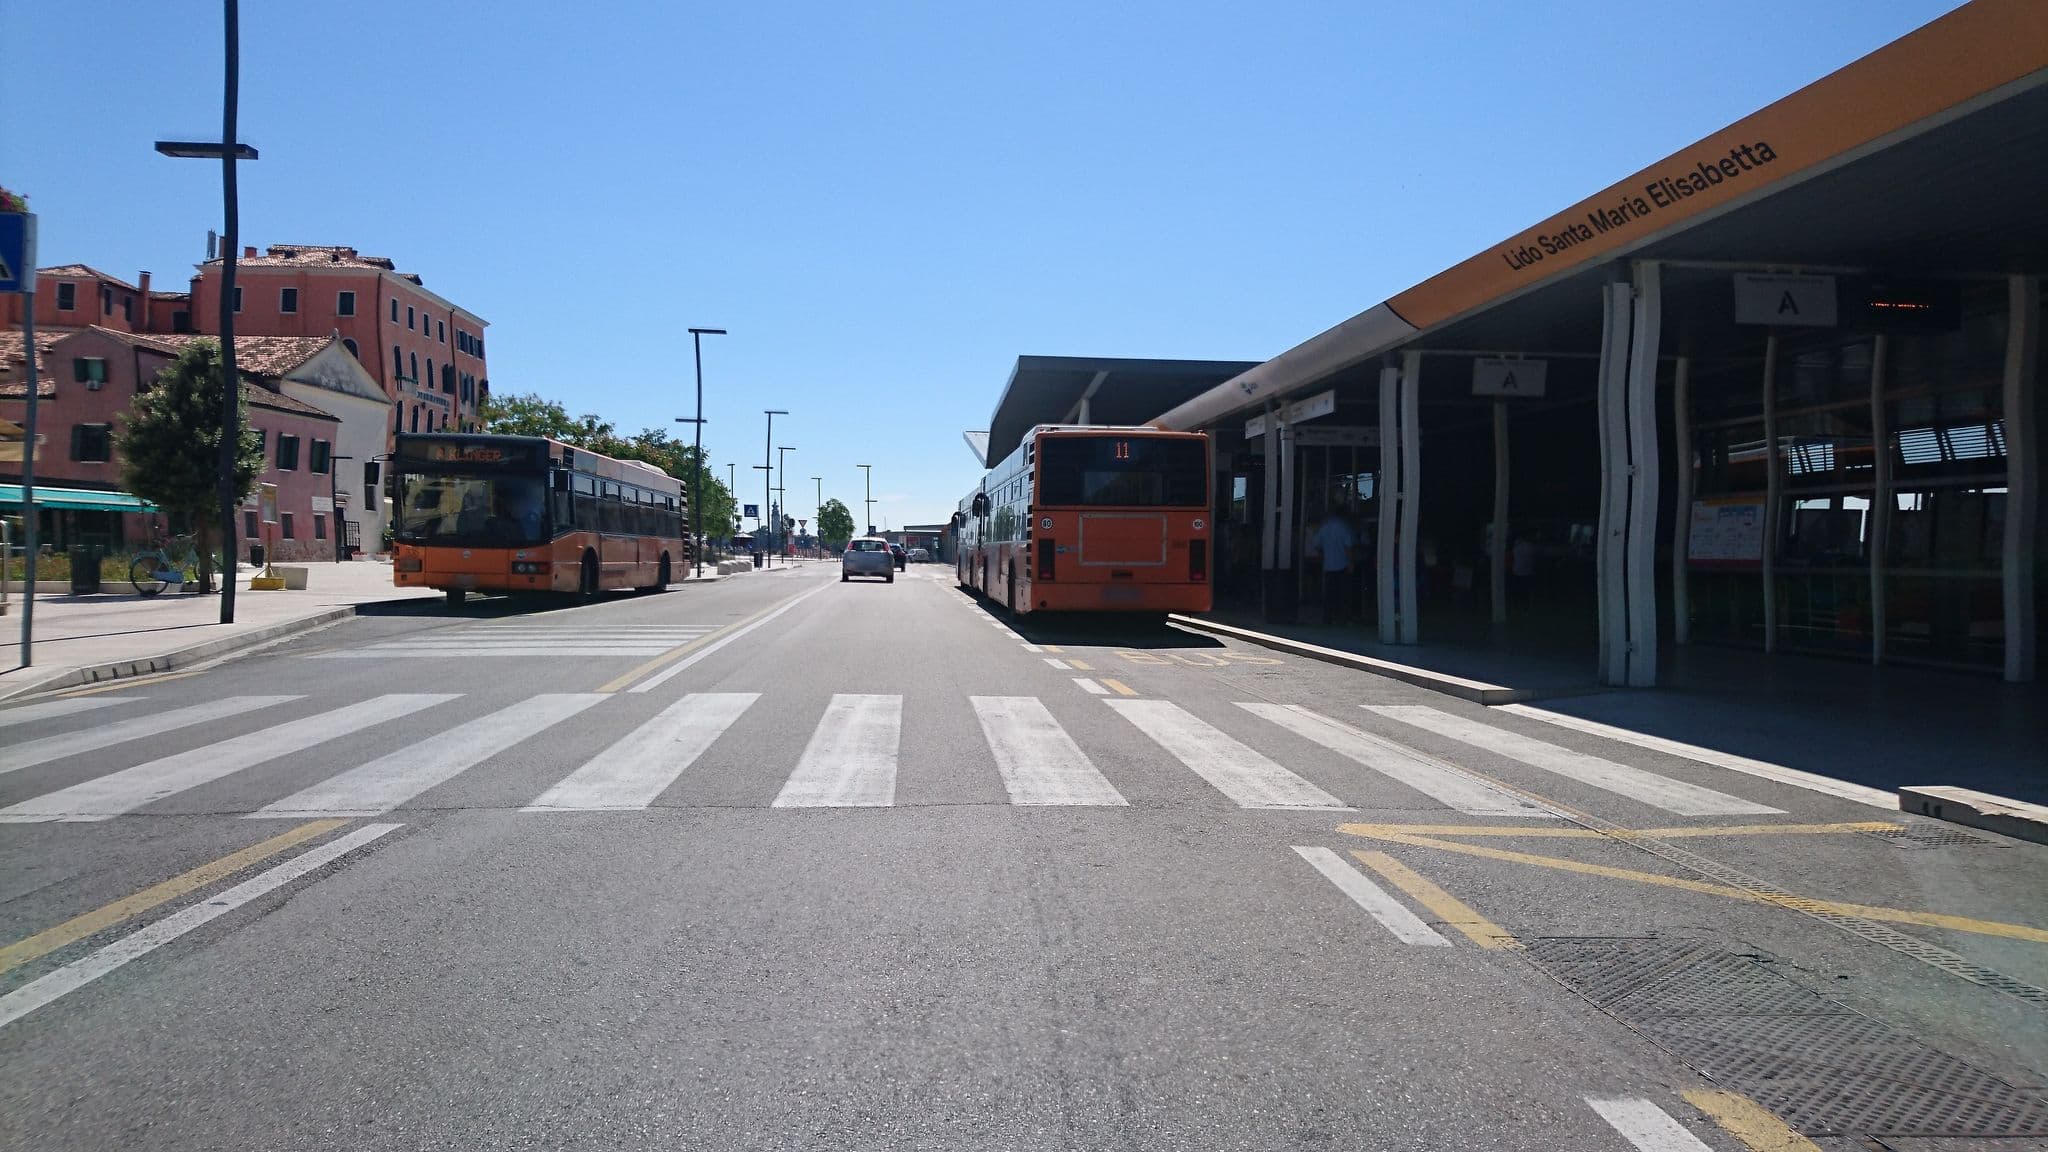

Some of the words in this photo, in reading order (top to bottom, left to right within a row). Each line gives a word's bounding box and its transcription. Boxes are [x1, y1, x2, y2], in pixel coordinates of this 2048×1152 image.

[1502, 241, 1543, 271] Lido
[1538, 222, 1593, 255] Santa
[1587, 196, 1652, 234] Maria
[1645, 140, 1778, 209] Elisabetta
[1778, 290, 1799, 315] A
[1503, 370, 1517, 389] A
[1115, 441, 1129, 459] 11
